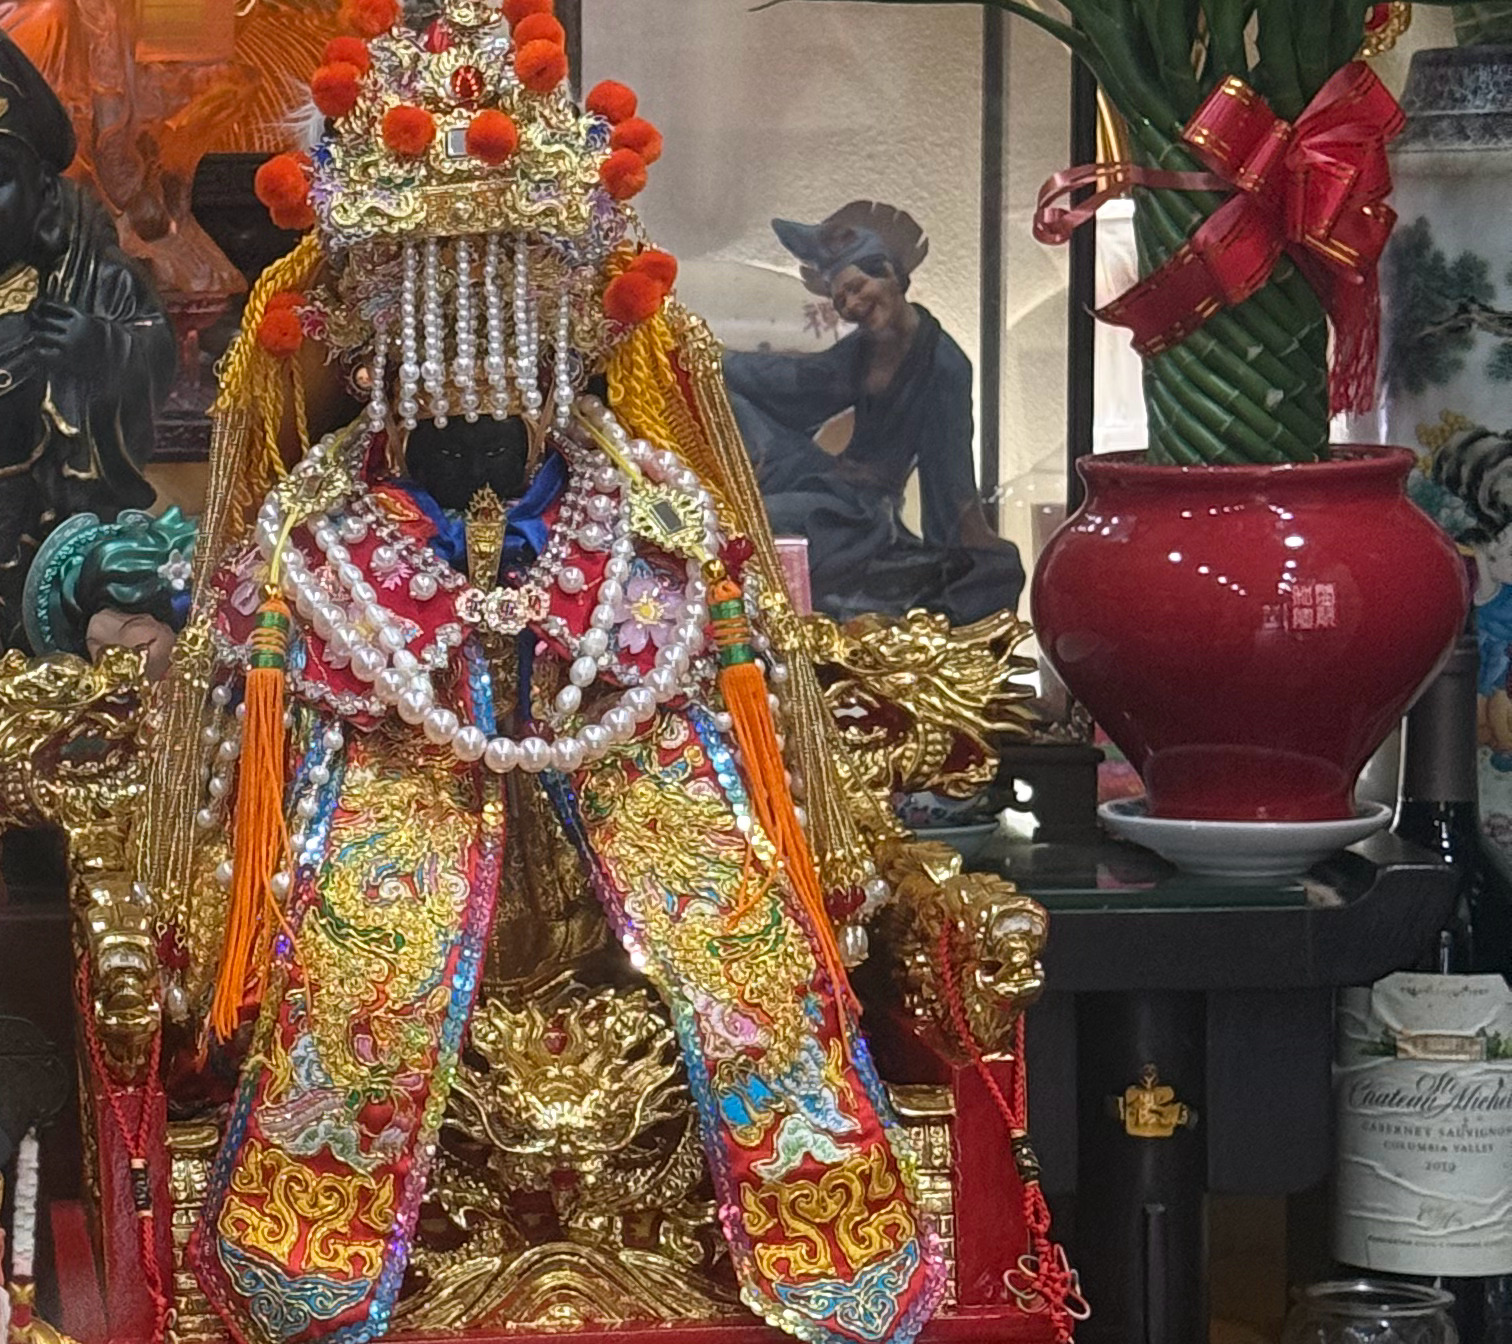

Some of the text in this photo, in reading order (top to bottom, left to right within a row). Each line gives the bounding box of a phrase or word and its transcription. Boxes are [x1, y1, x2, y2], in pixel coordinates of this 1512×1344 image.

[1361, 1120, 1432, 1138] CABERNET
[1383, 1140, 1494, 1154] COLUMBIA VALLEY
